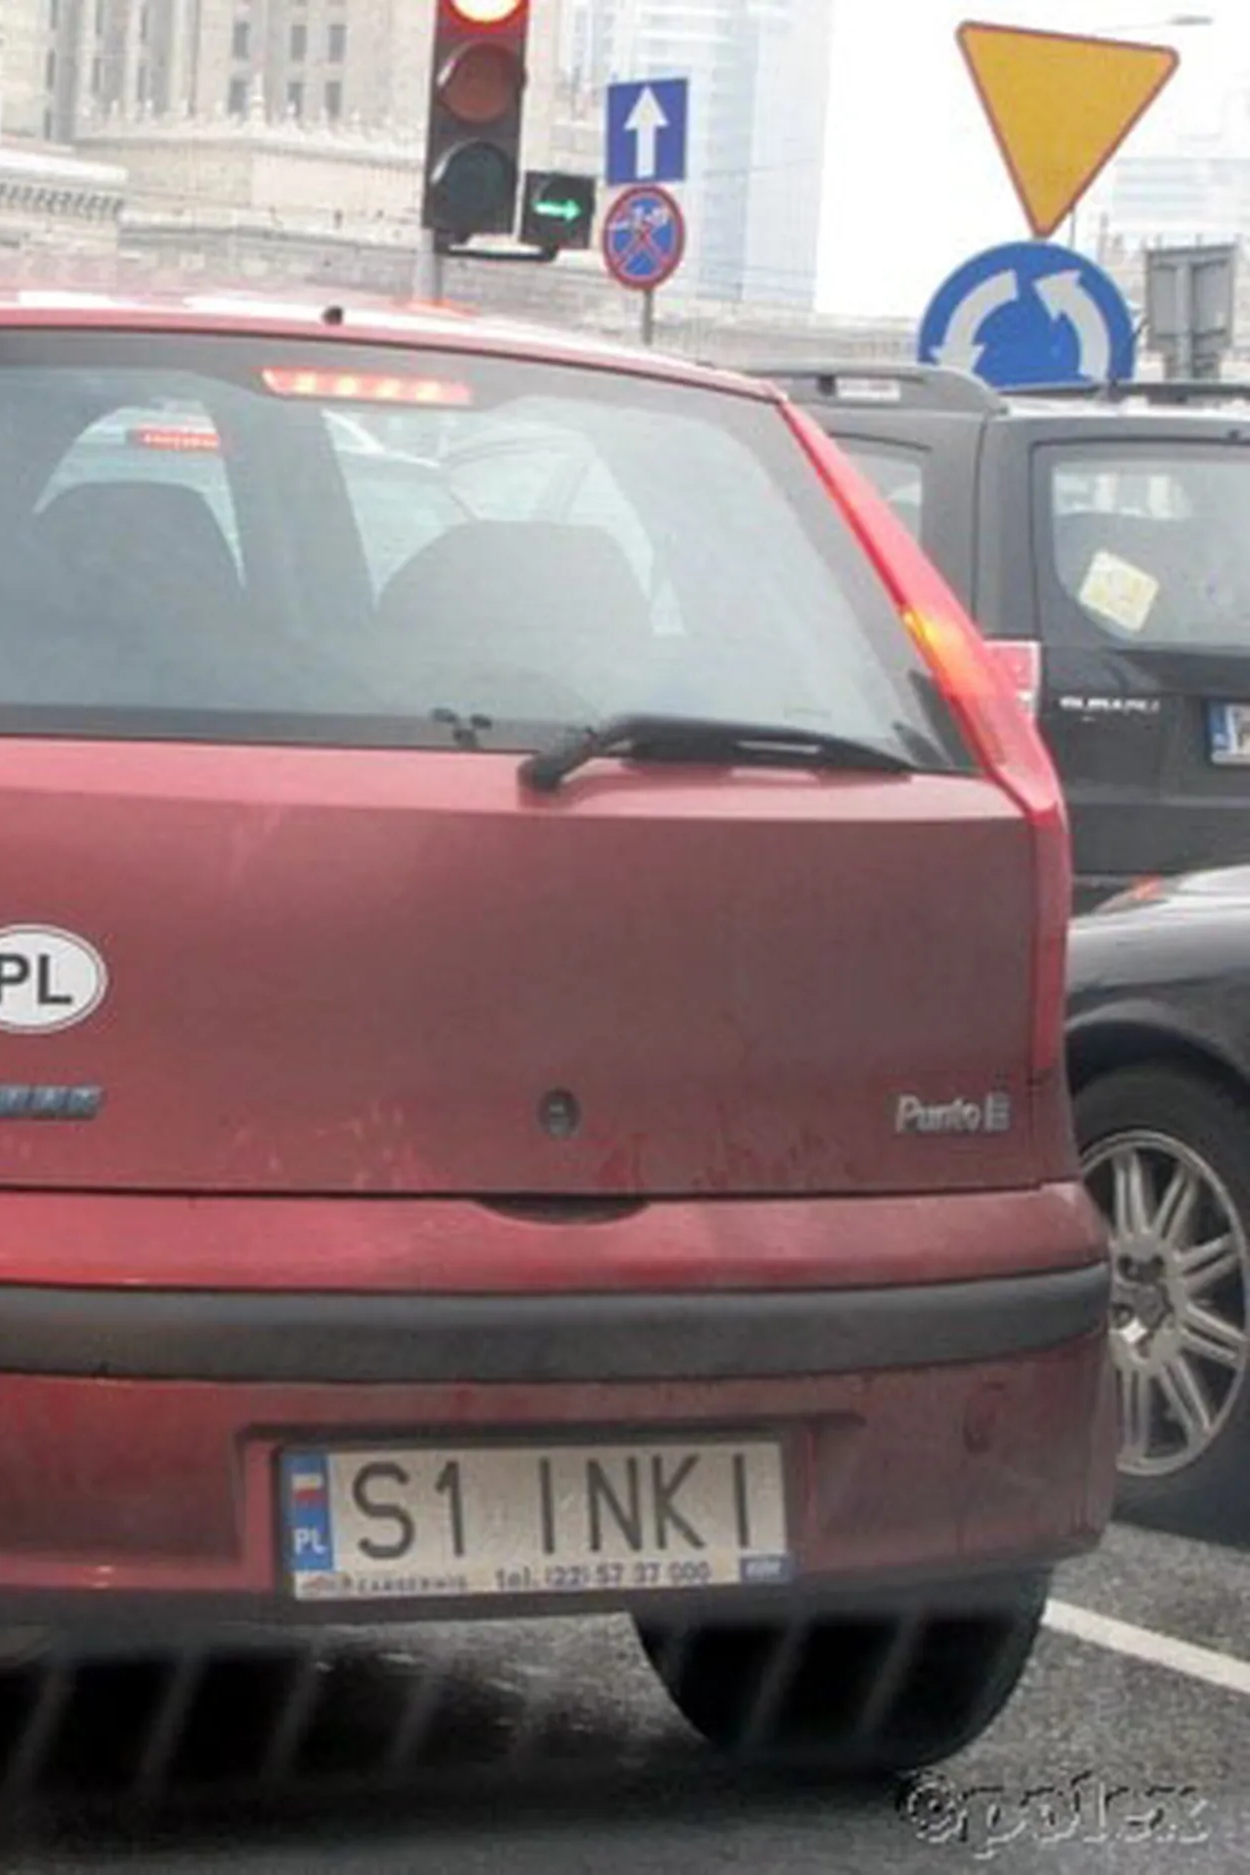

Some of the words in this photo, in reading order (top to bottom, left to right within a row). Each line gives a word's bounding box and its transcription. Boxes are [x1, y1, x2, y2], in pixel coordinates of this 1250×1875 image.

[895, 1093, 982, 1133] Punto
[351, 1458, 465, 1560] S1
[293, 1527, 326, 1556] PL
